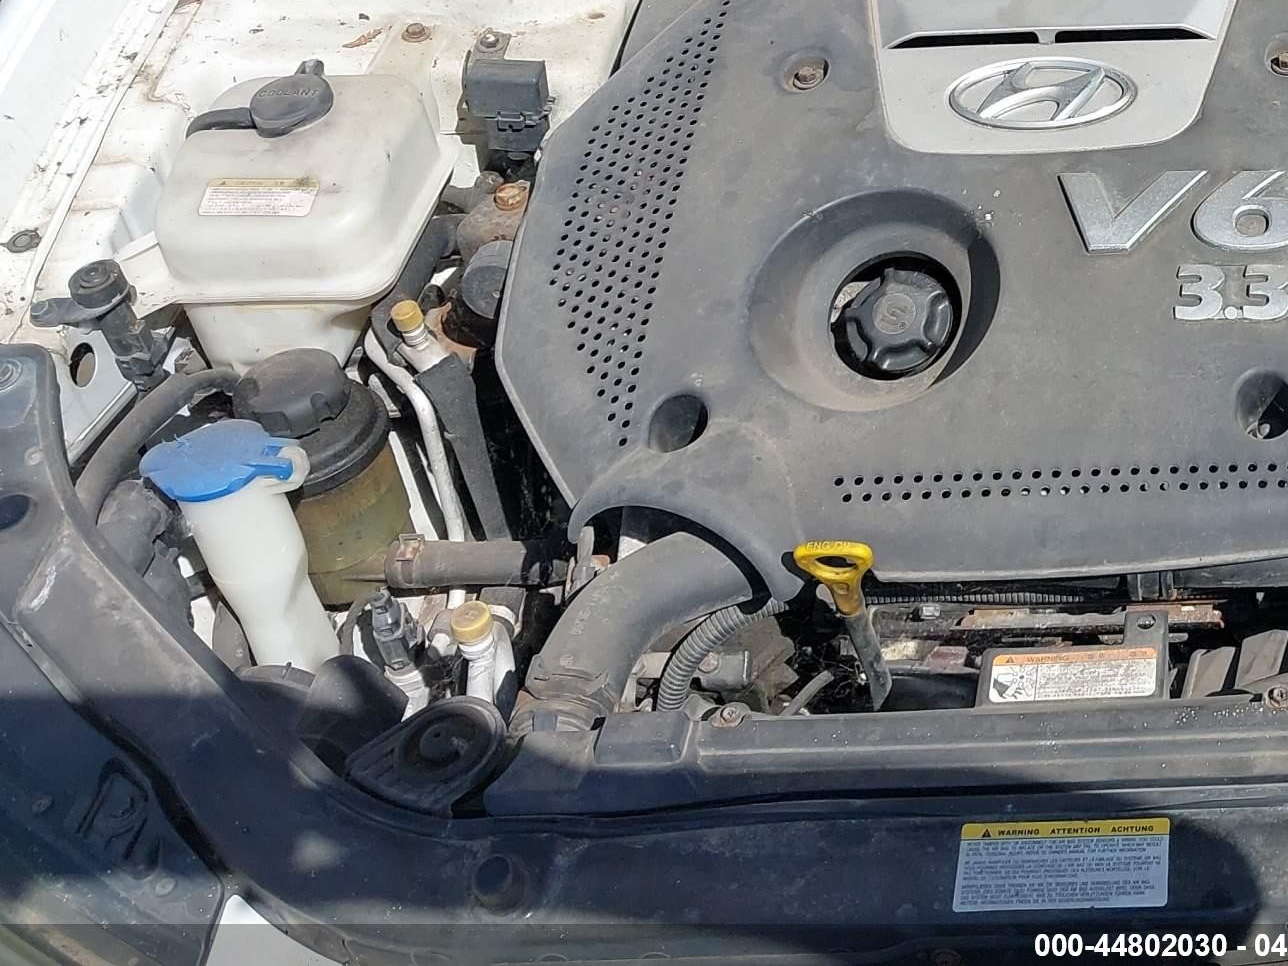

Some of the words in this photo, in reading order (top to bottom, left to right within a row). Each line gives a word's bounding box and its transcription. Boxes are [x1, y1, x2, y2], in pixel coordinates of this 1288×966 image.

[258, 89, 319, 98] COOLANT
[806, 540, 831, 550] ENG
[997, 828, 1040, 836] WARNING
[1050, 827, 1101, 835] ATTENTION
[1111, 825, 1154, 833] ACHTUNG
